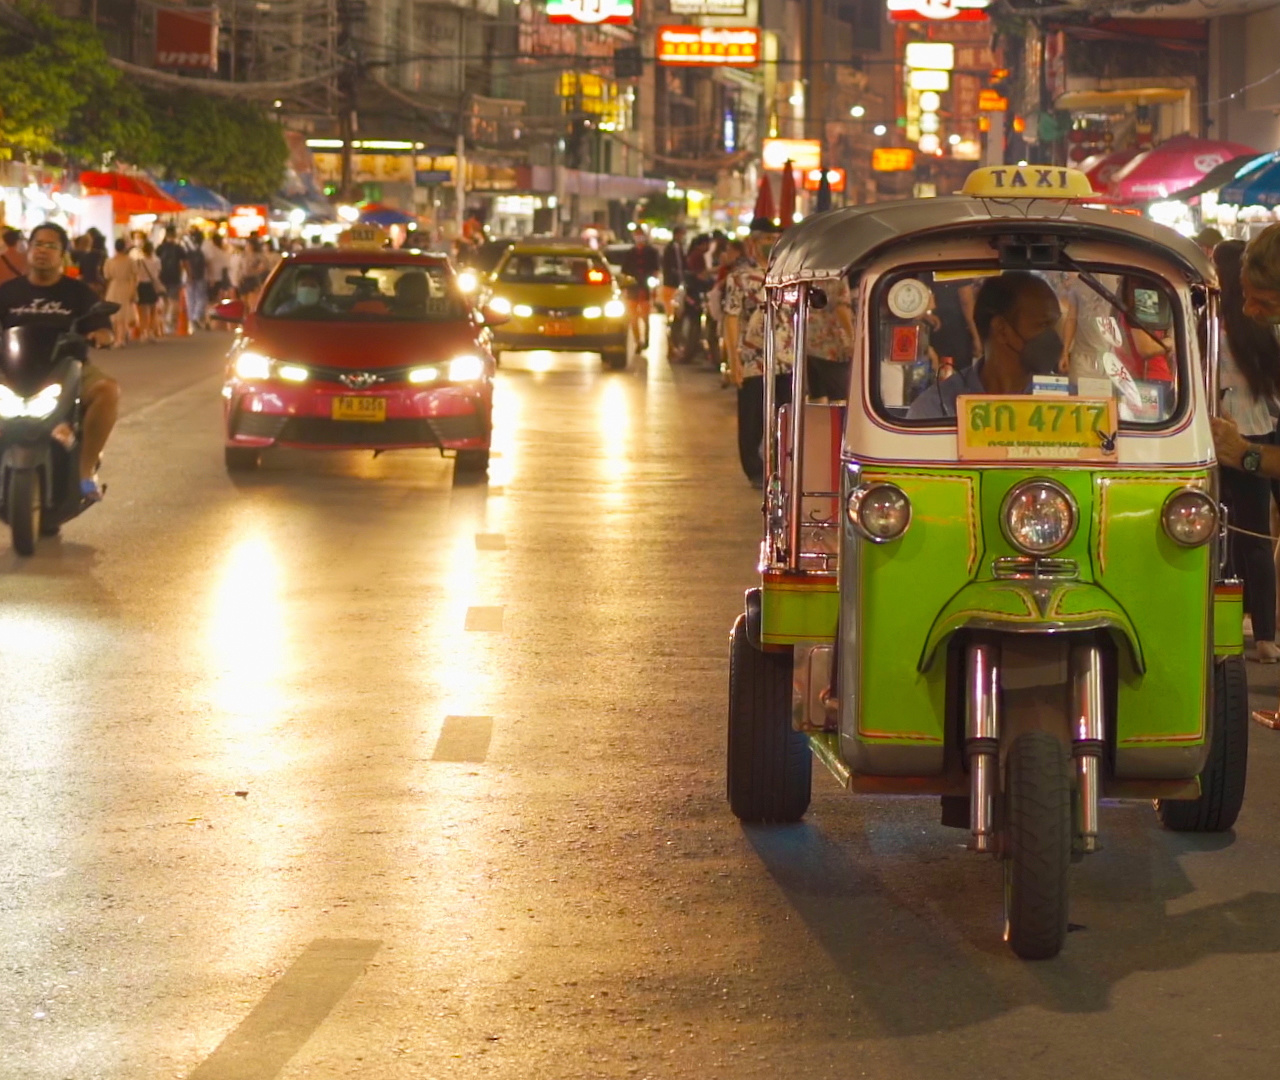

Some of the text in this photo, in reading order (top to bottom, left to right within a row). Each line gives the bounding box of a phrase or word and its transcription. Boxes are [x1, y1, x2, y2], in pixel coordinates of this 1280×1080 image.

[991, 169, 1068, 188] TAXI
[352, 230, 375, 242] TAXI
[970, 402, 1105, 434] สก 4717
